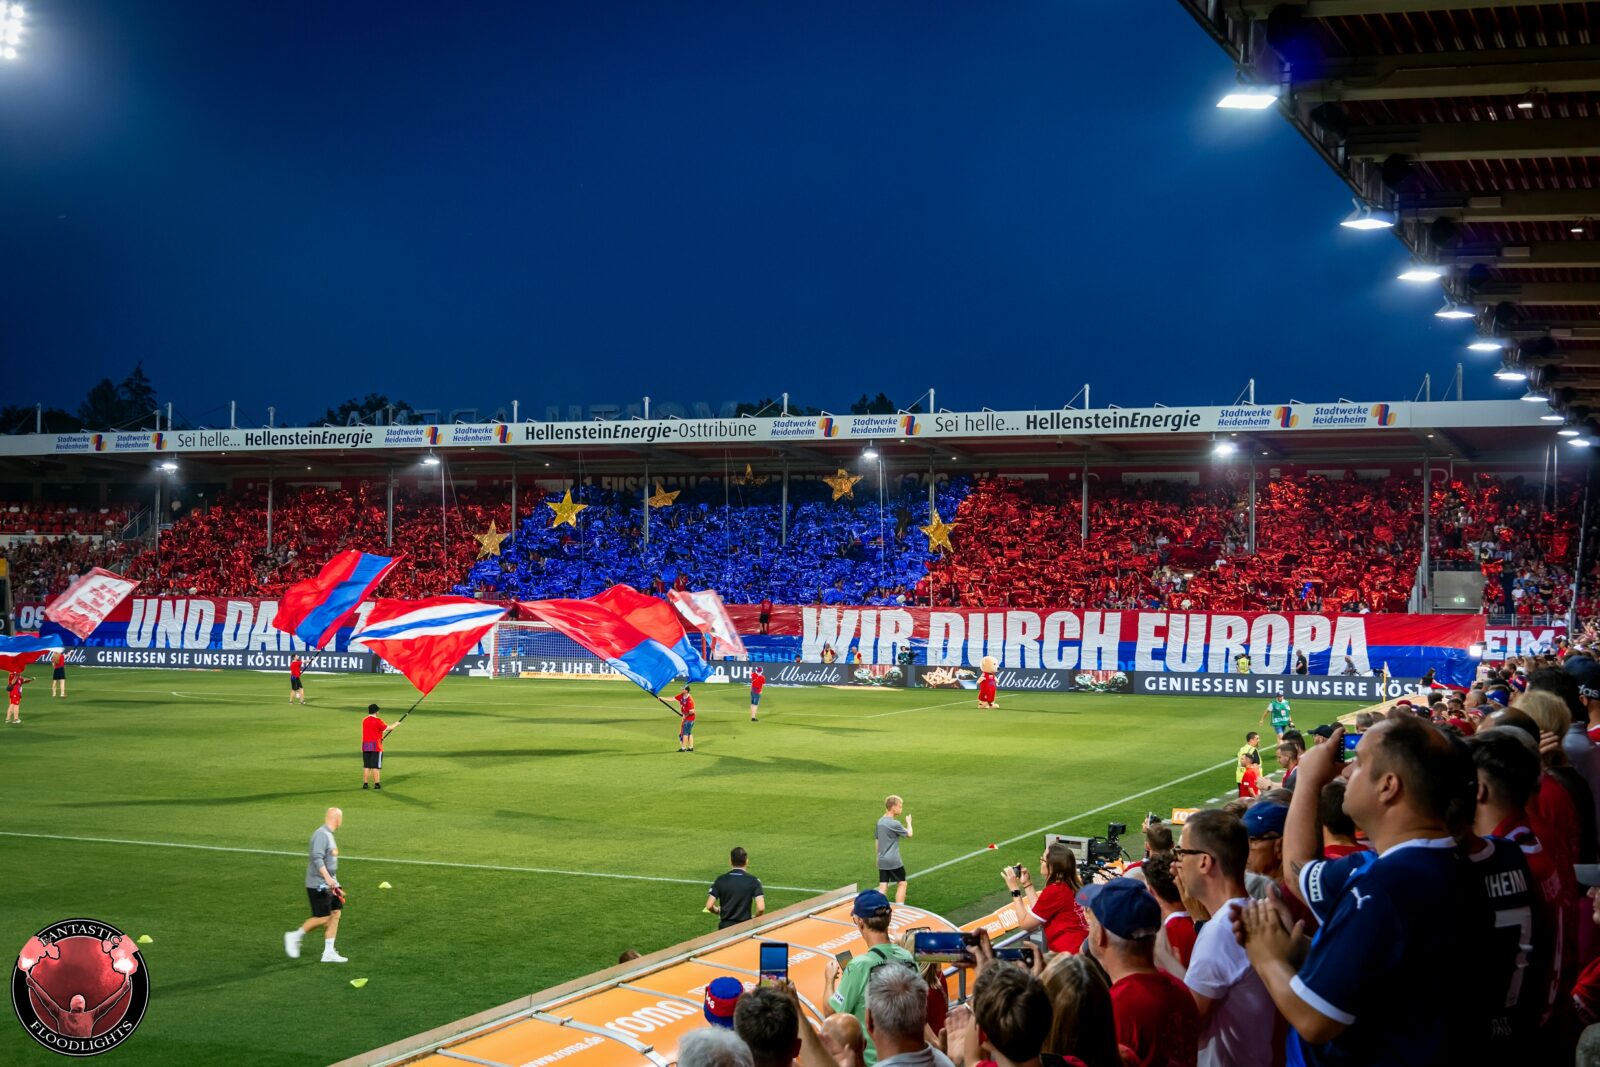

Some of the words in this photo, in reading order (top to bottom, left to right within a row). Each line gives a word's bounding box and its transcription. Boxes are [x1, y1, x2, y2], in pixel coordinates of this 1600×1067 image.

[1220, 407, 1272, 417] Stadtwerke
[1315, 405, 1368, 415] Stadtwerke
[773, 419, 816, 428] Stadtwerke
[853, 417, 898, 426] Stadtwerke
[935, 416, 959, 432] Sei
[965, 414, 1020, 431] helle...
[1026, 410, 1201, 431] HellensteinEnergie
[1218, 417, 1270, 426] Heidenheim
[1312, 414, 1367, 424] Heidenheim
[386, 428, 424, 436] Stadtwerke
[455, 427, 493, 435] Stadtwerke
[771, 427, 815, 436] Heidenheim
[851, 425, 896, 434] Heidenheim
[178, 433, 195, 447] Sei
[200, 431, 240, 447] helle...
[245, 429, 373, 448] HellensteinEnergie
[384, 435, 423, 444] Heidenheim
[453, 434, 492, 442] Heidenheim
[126, 598, 215, 649] UND
[801, 606, 915, 666] WIR
[926, 611, 1121, 671] DURCH
[1134, 612, 1372, 677] EUROPA
[97, 651, 166, 664] GENIESSEN
[170, 652, 190, 665] SIE
[193, 653, 243, 666] UNSERE
[562, 662, 594, 675] UHR
[770, 665, 841, 684] Albstüble
[1144, 676, 1249, 693] GENIESSEN
[1255, 679, 1285, 695] SIE
[1291, 680, 1368, 696] UNSERE
[1494, 905, 1534, 1008] 7
[604, 999, 699, 1039] roma
